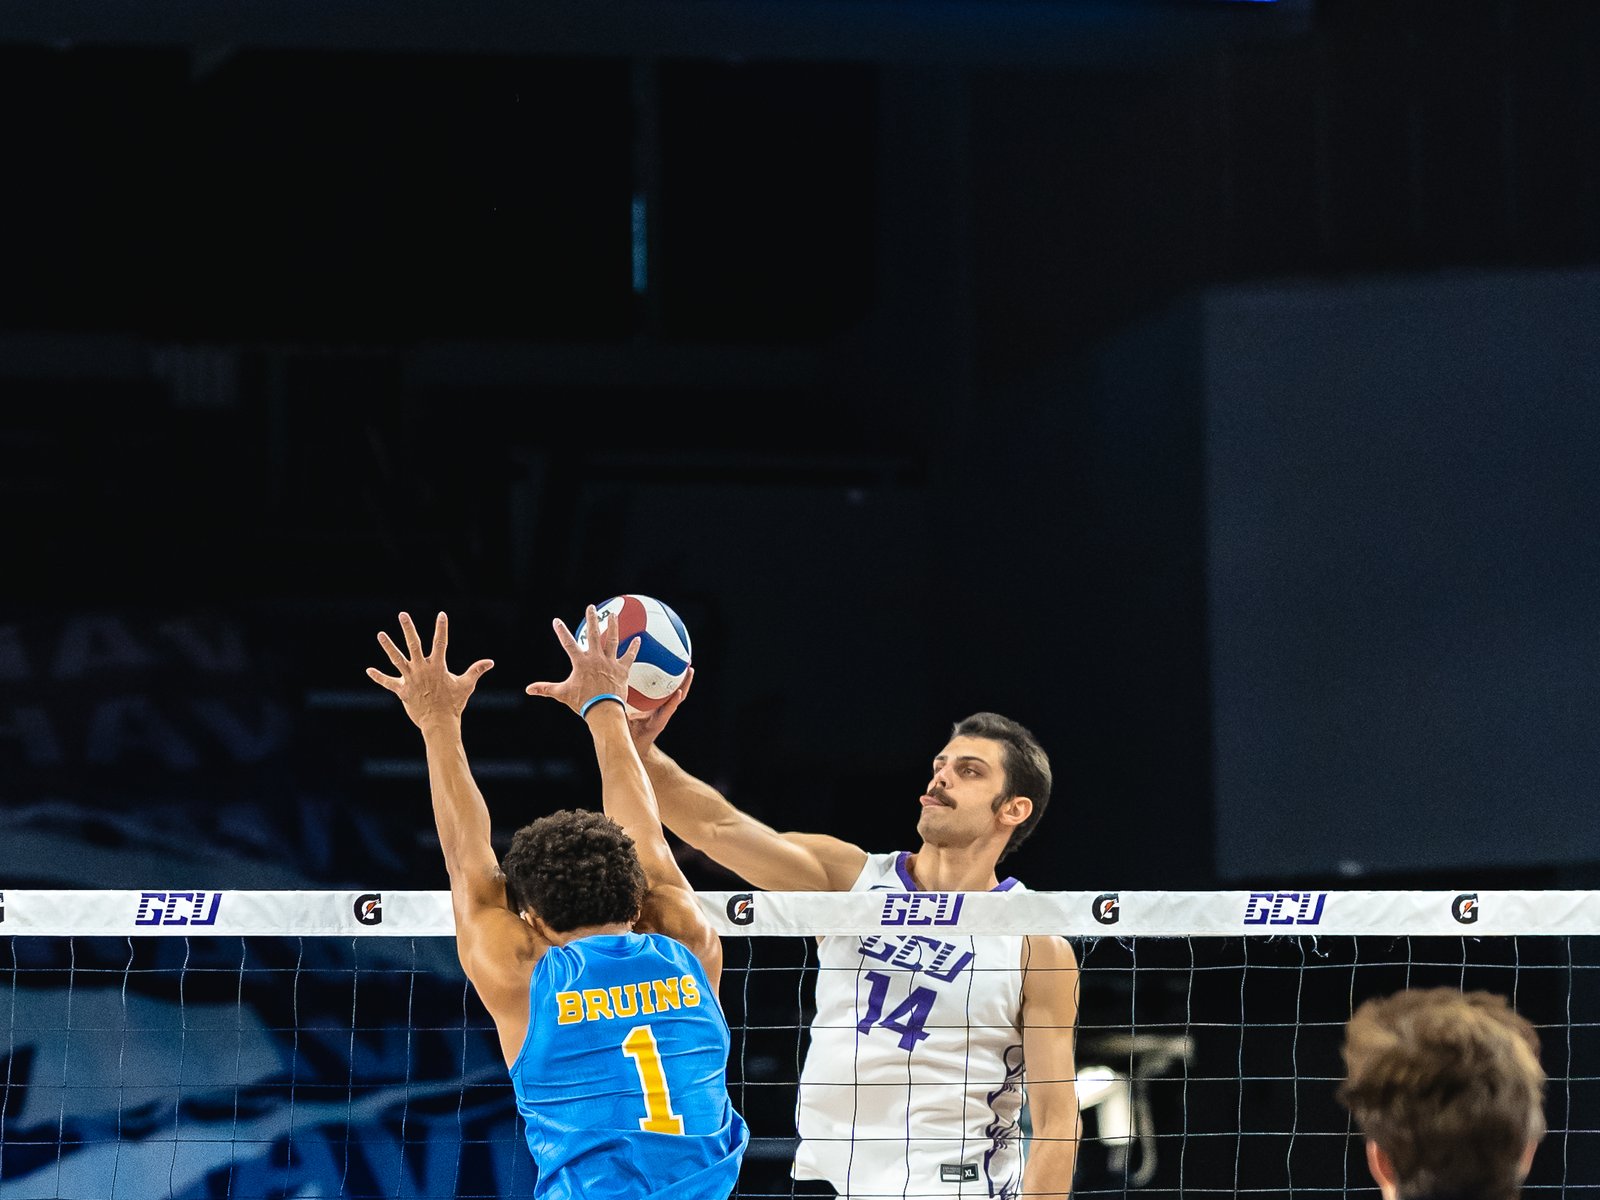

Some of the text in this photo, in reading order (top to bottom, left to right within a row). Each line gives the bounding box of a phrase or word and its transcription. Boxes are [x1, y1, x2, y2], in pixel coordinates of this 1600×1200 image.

[135, 892, 223, 926] GCU
[353, 893, 382, 926] G
[726, 893, 754, 926] G
[880, 892, 965, 926] GCU
[1092, 893, 1119, 925] G
[1243, 892, 1327, 925] GCU
[1451, 893, 1478, 925] G
[556, 974, 701, 1026] BRUINS
[857, 970, 938, 1051] 14
[621, 1024, 685, 1136] 1
[964, 1169, 975, 1178] XL
